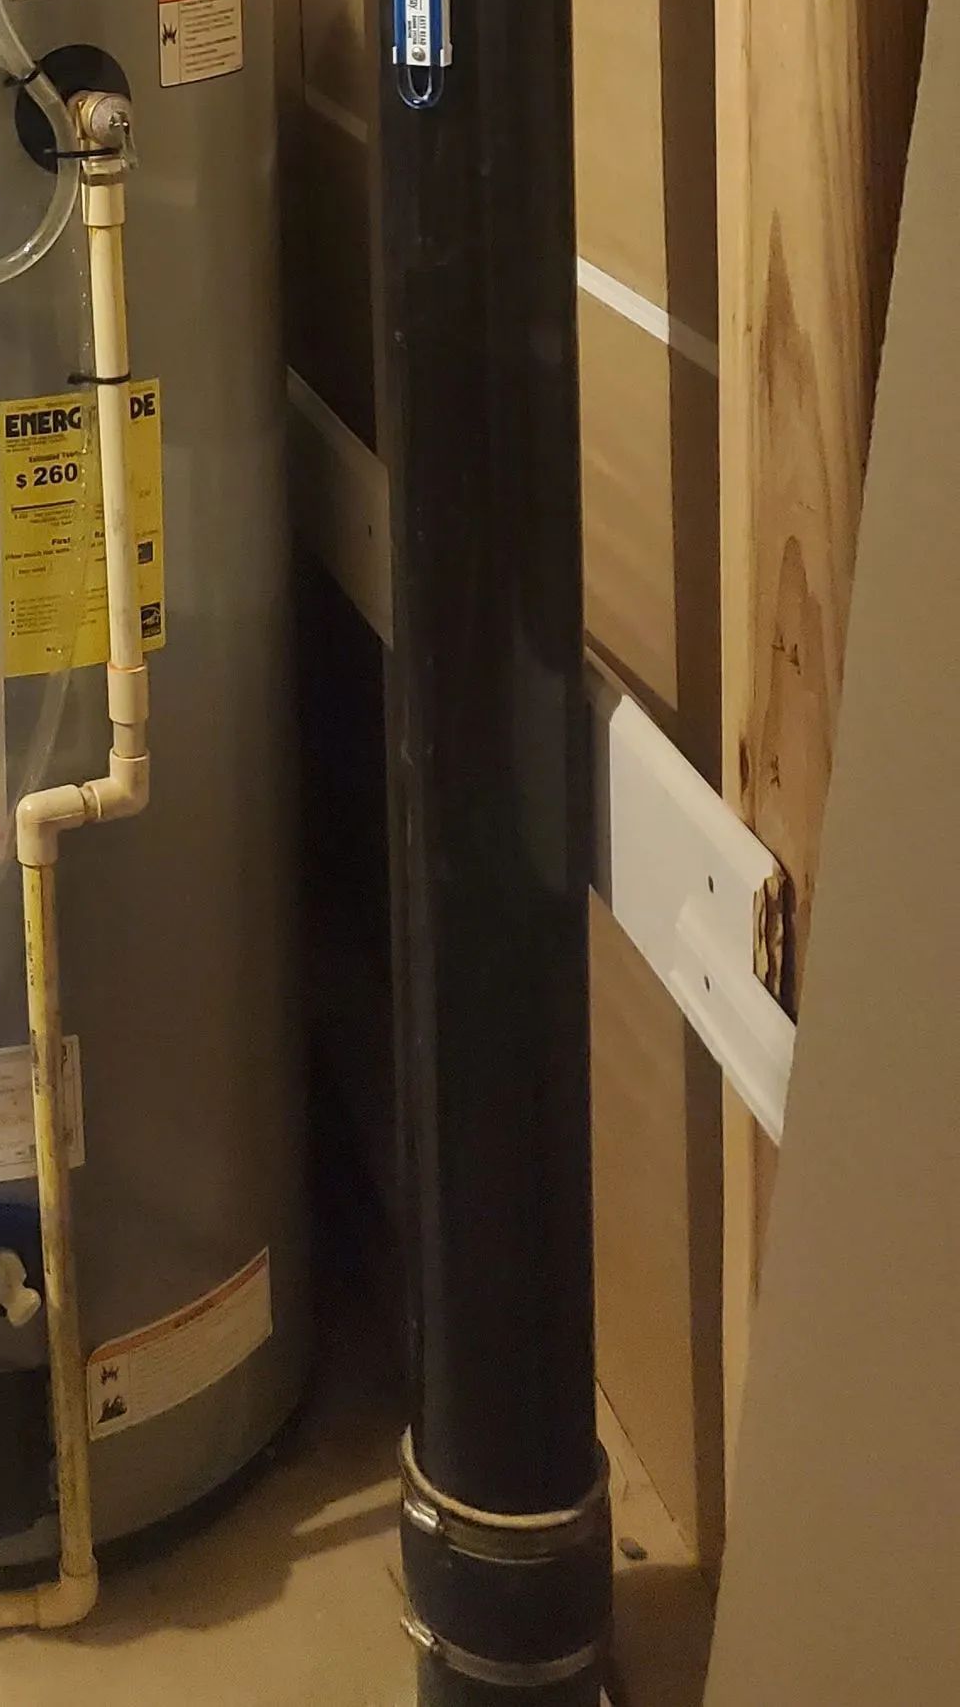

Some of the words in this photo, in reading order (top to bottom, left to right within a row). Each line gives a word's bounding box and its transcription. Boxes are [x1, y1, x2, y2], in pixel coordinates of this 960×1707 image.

[16, 473, 28, 490] $
[33, 462, 78, 487] 260
[51, 536, 71, 546] First
